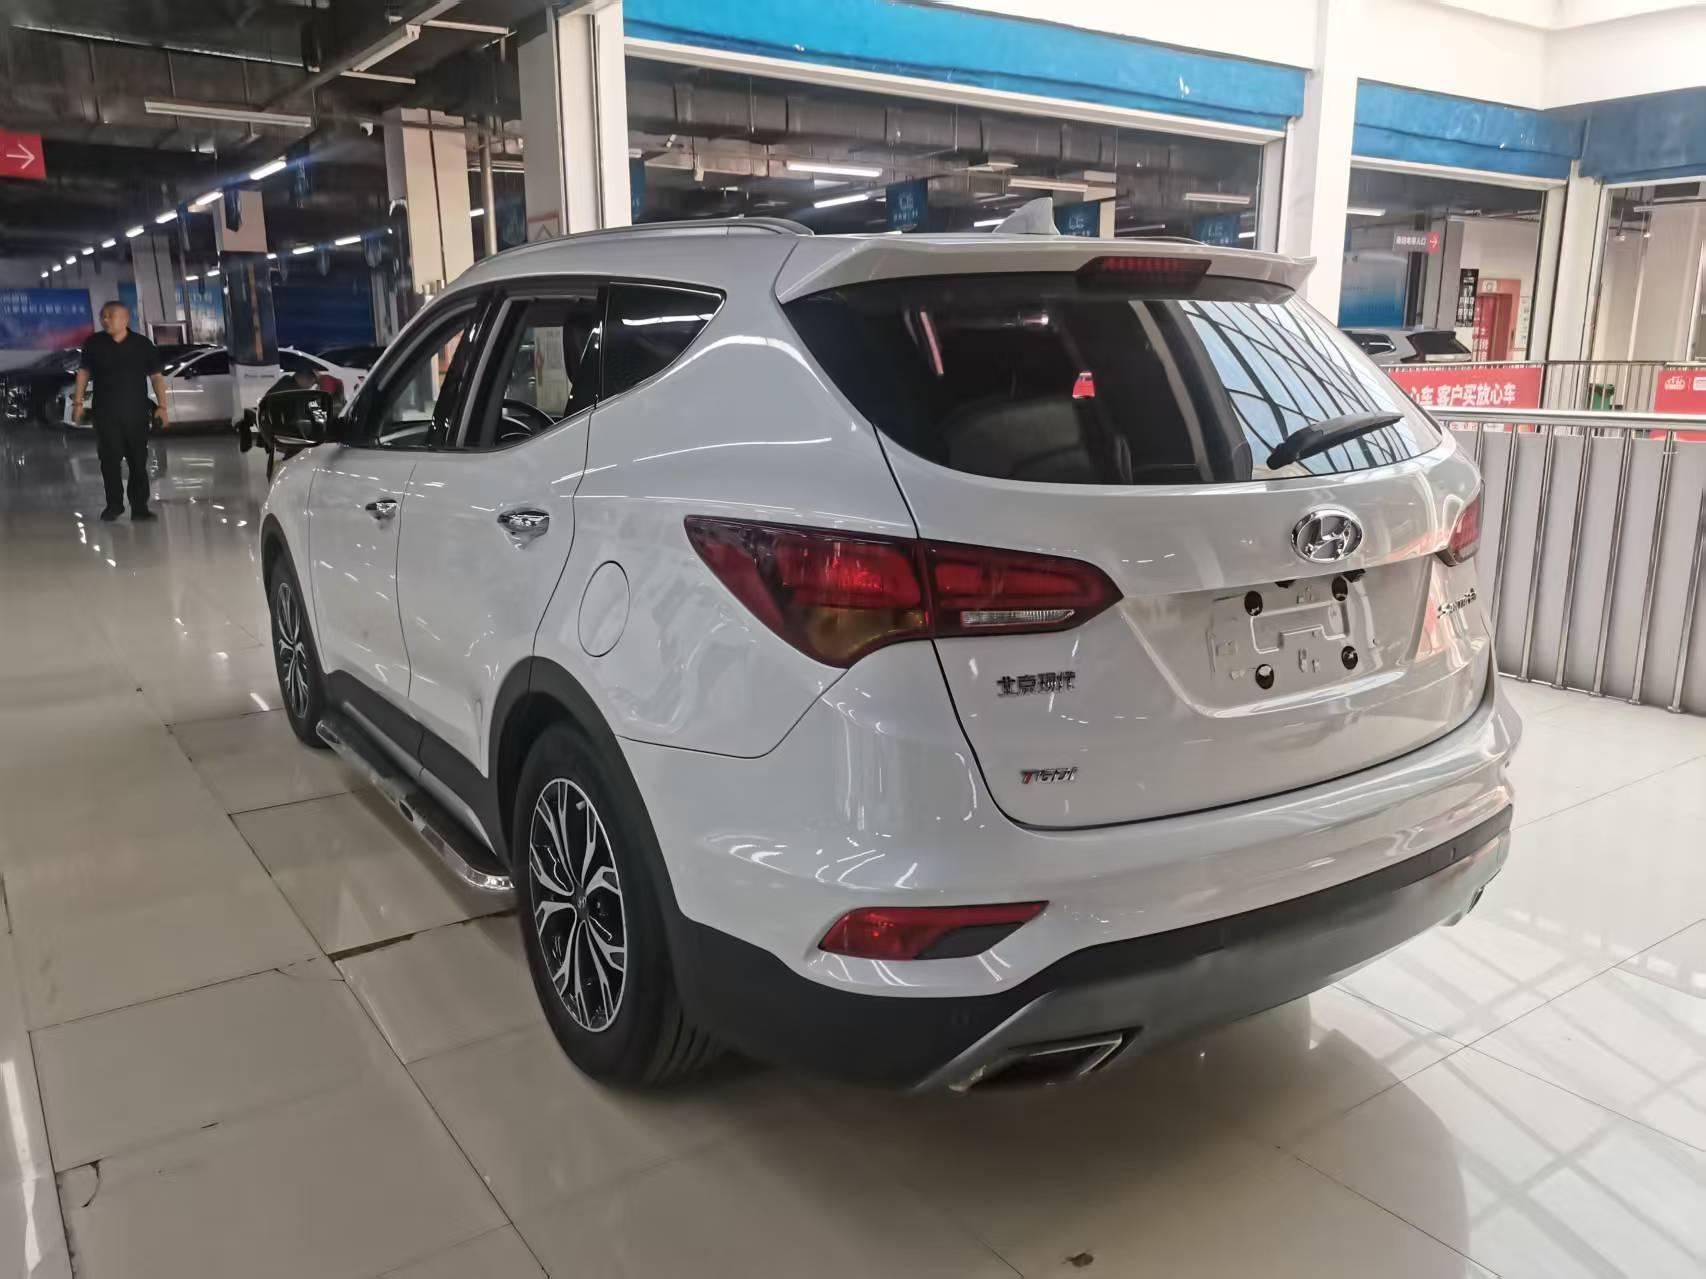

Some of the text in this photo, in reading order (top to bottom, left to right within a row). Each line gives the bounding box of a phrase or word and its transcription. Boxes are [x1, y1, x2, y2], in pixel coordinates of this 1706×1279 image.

[1436, 382, 1517, 407] 客户买放心车
[996, 671, 1076, 698] 北京现代
